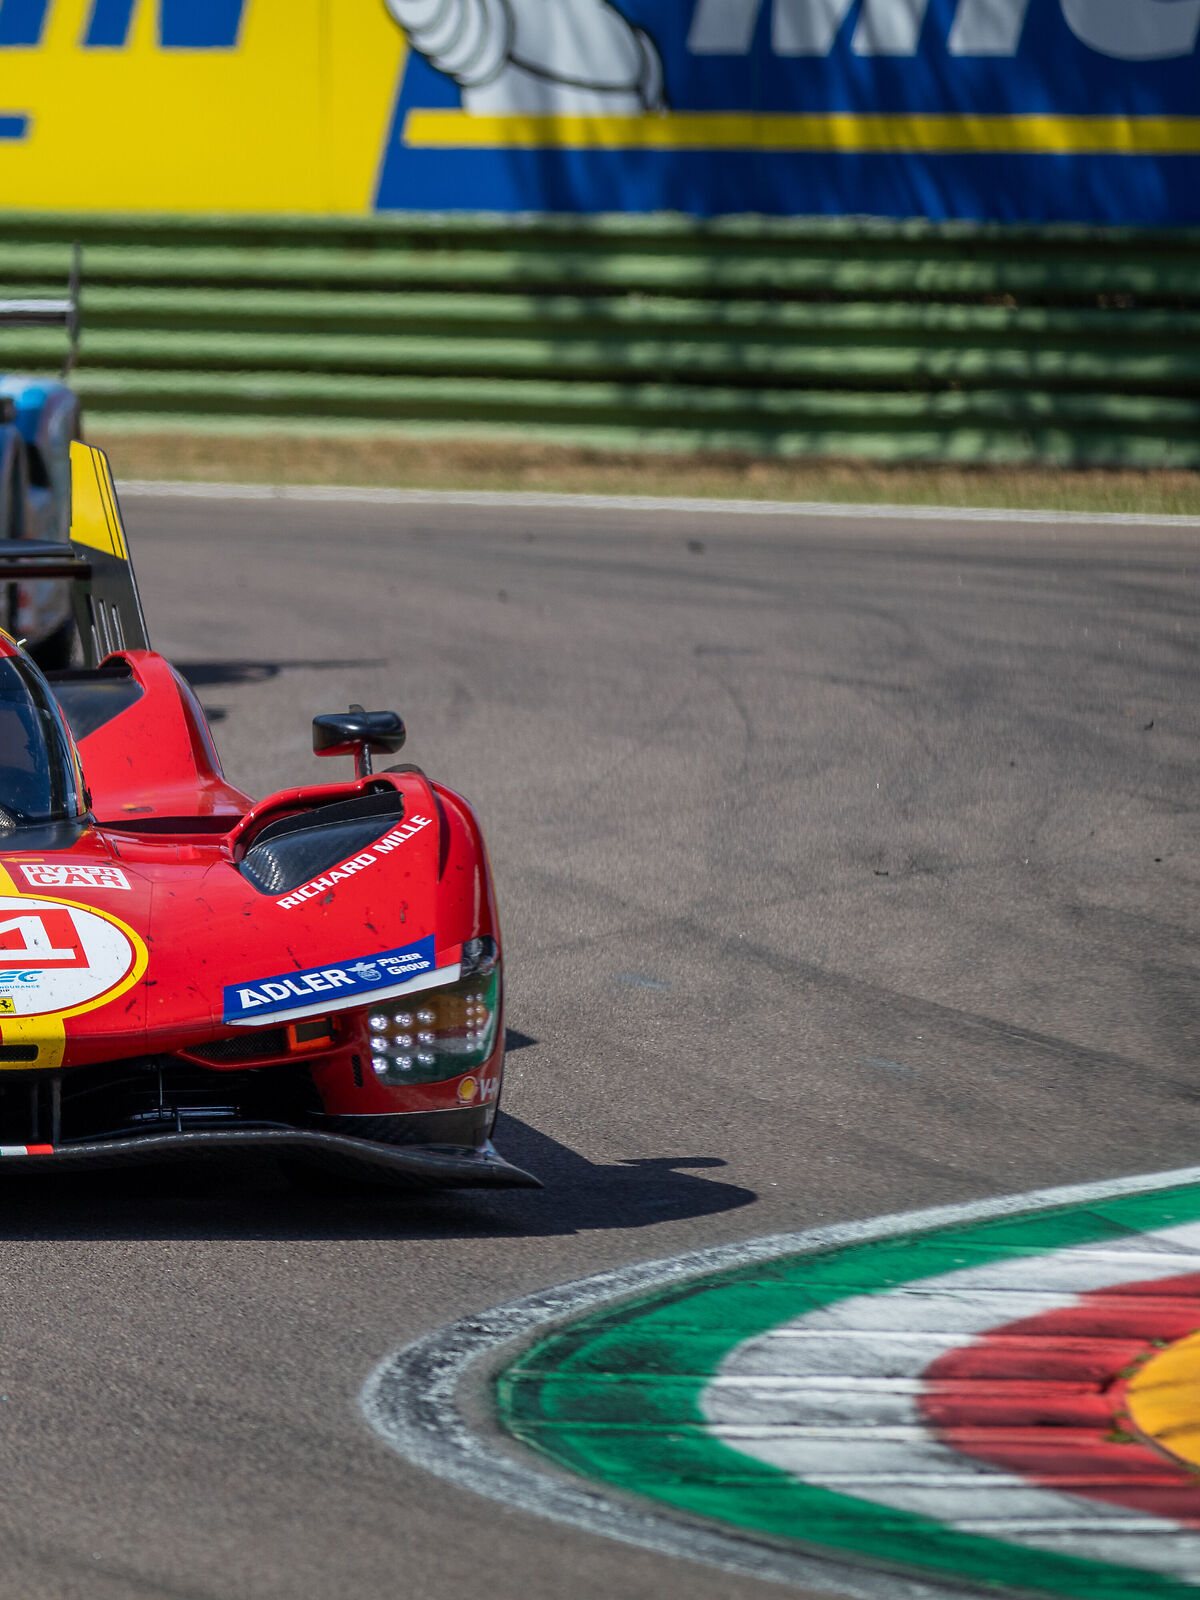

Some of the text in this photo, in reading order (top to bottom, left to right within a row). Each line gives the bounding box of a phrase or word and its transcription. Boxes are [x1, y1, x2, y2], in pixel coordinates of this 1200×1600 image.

[277, 815, 432, 910] RICHARD MILLE
[27, 866, 118, 876] HYPER
[32, 873, 123, 886] CAR
[377, 952, 422, 966] PELZER
[387, 960, 431, 975] GROUP
[236, 969, 356, 1009] ADLER
